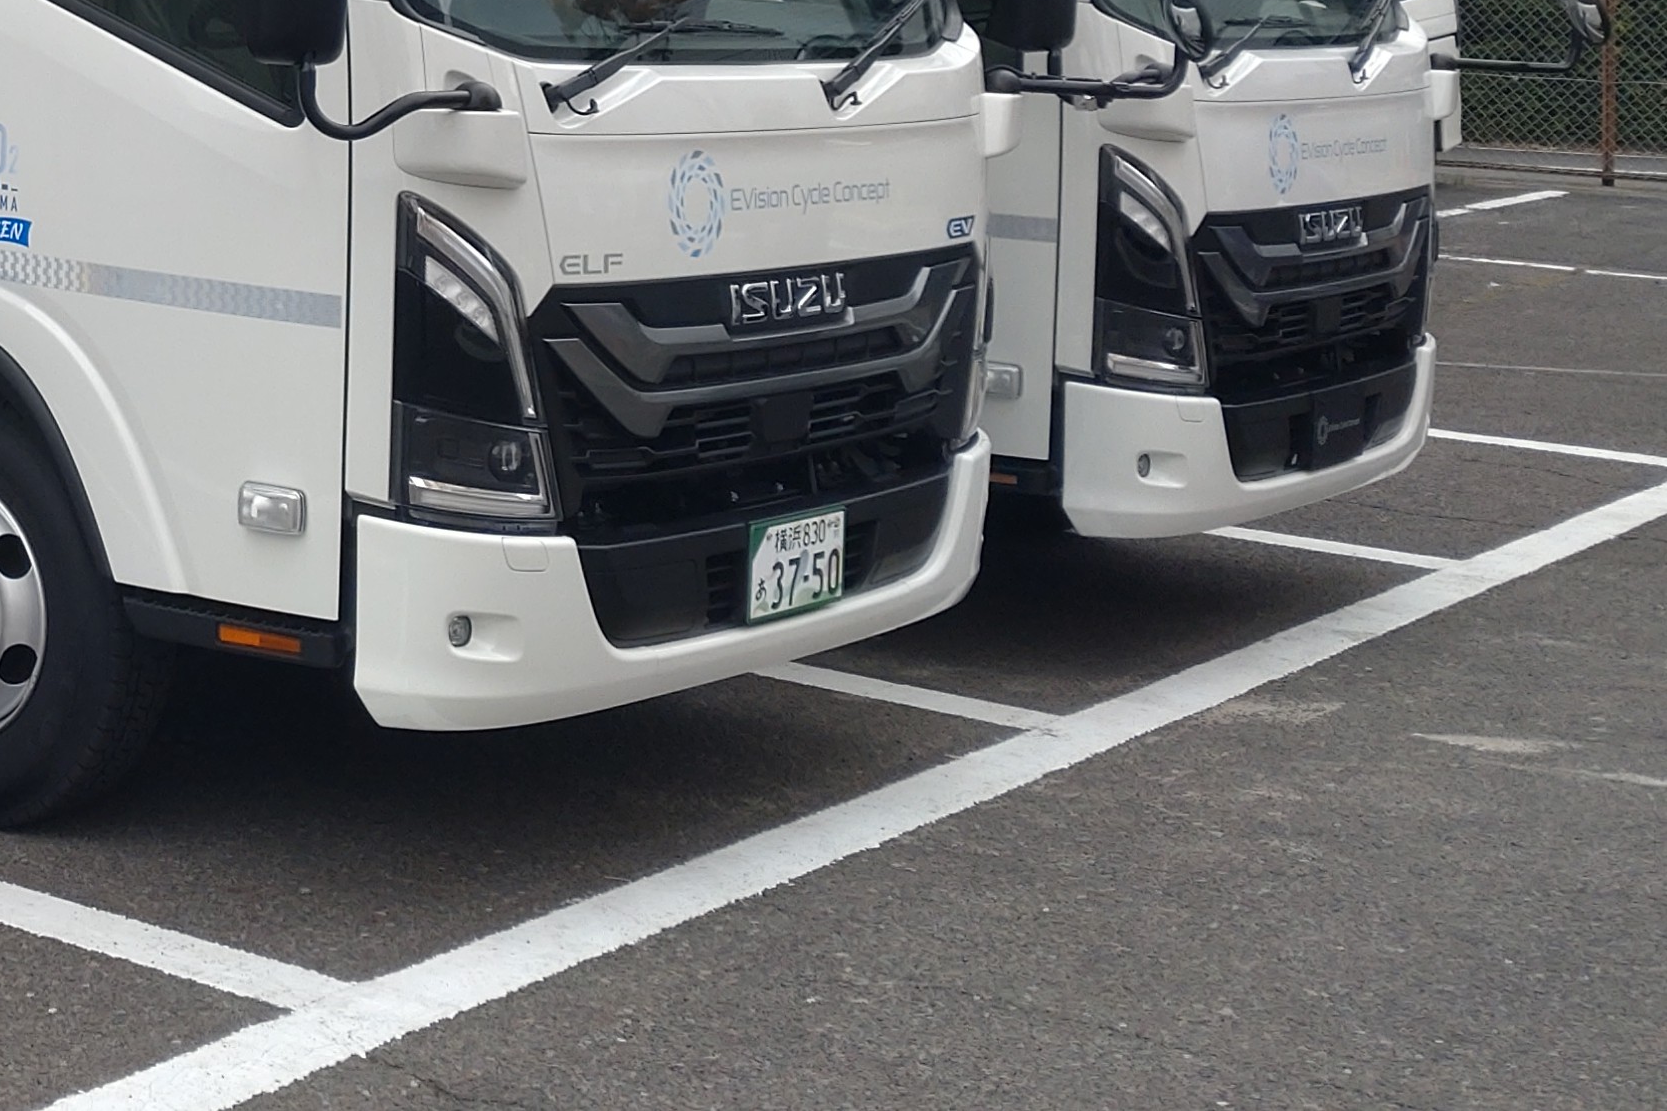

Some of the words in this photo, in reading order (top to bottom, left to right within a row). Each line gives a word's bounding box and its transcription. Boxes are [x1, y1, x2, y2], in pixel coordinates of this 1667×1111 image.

[730, 187, 789, 211] EVision
[792, 182, 830, 215] Cycle
[833, 178, 890, 204] Concept
[949, 218, 973, 237] EV
[1298, 206, 1362, 245] ISUZU
[559, 253, 624, 276] ELF
[729, 272, 847, 327] ISUZU
[771, 548, 840, 610] 37-50
